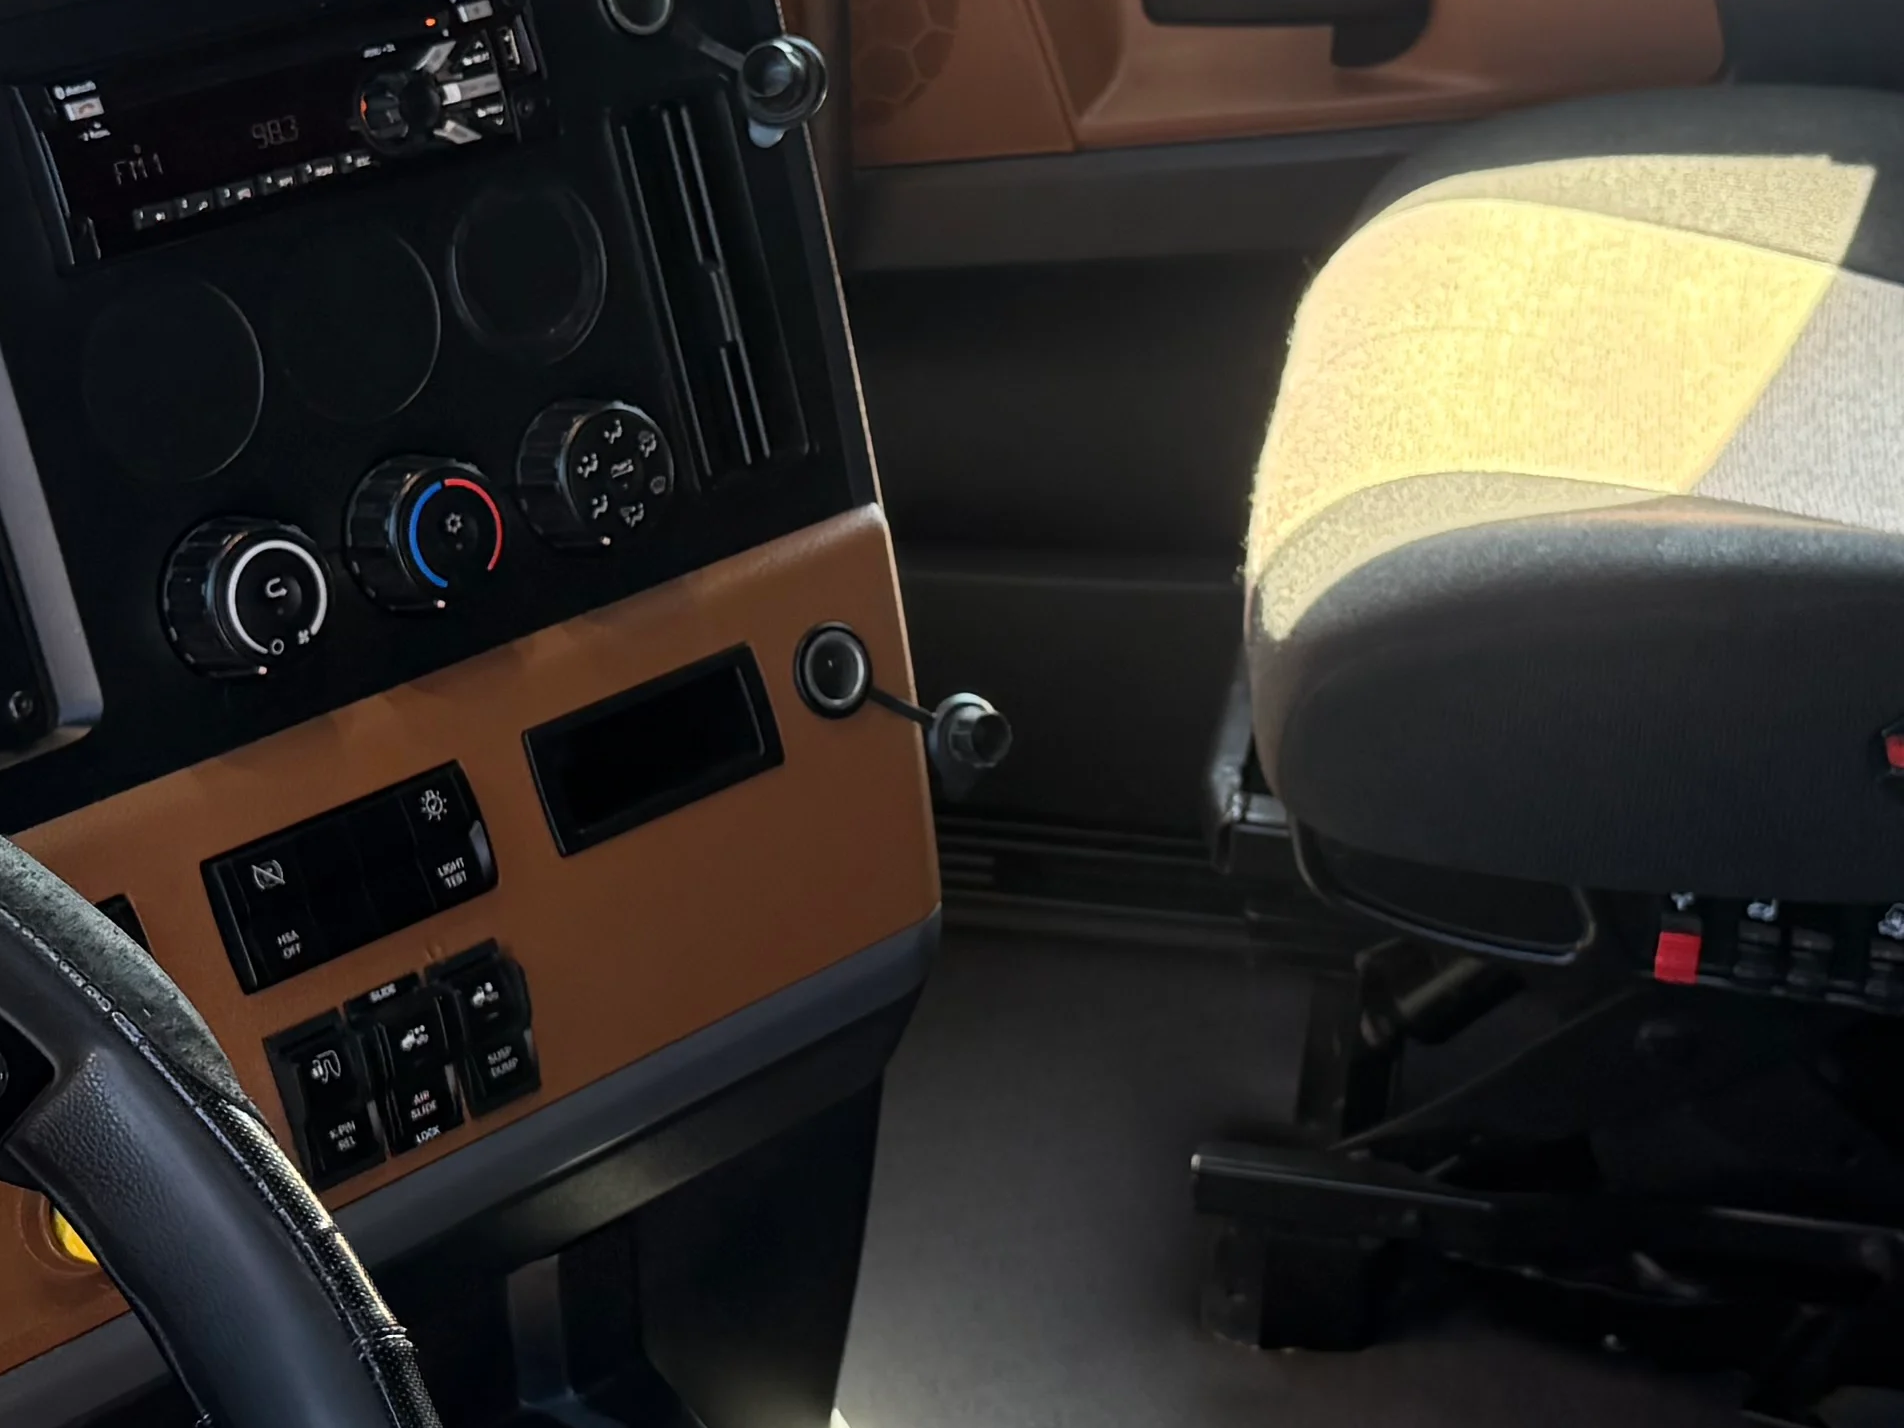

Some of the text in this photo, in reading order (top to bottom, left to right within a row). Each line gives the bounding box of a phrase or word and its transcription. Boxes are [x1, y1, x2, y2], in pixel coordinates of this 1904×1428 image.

[437, 856, 465, 878] LIGHT
[444, 870, 467, 889] TEST
[277, 929, 300, 948] HSA
[282, 942, 302, 960] OFF
[369, 983, 397, 1003] SLIDE
[413, 1089, 431, 1106] AIR
[410, 1100, 437, 1120] SLIDE
[415, 1124, 442, 1145] LOCK
